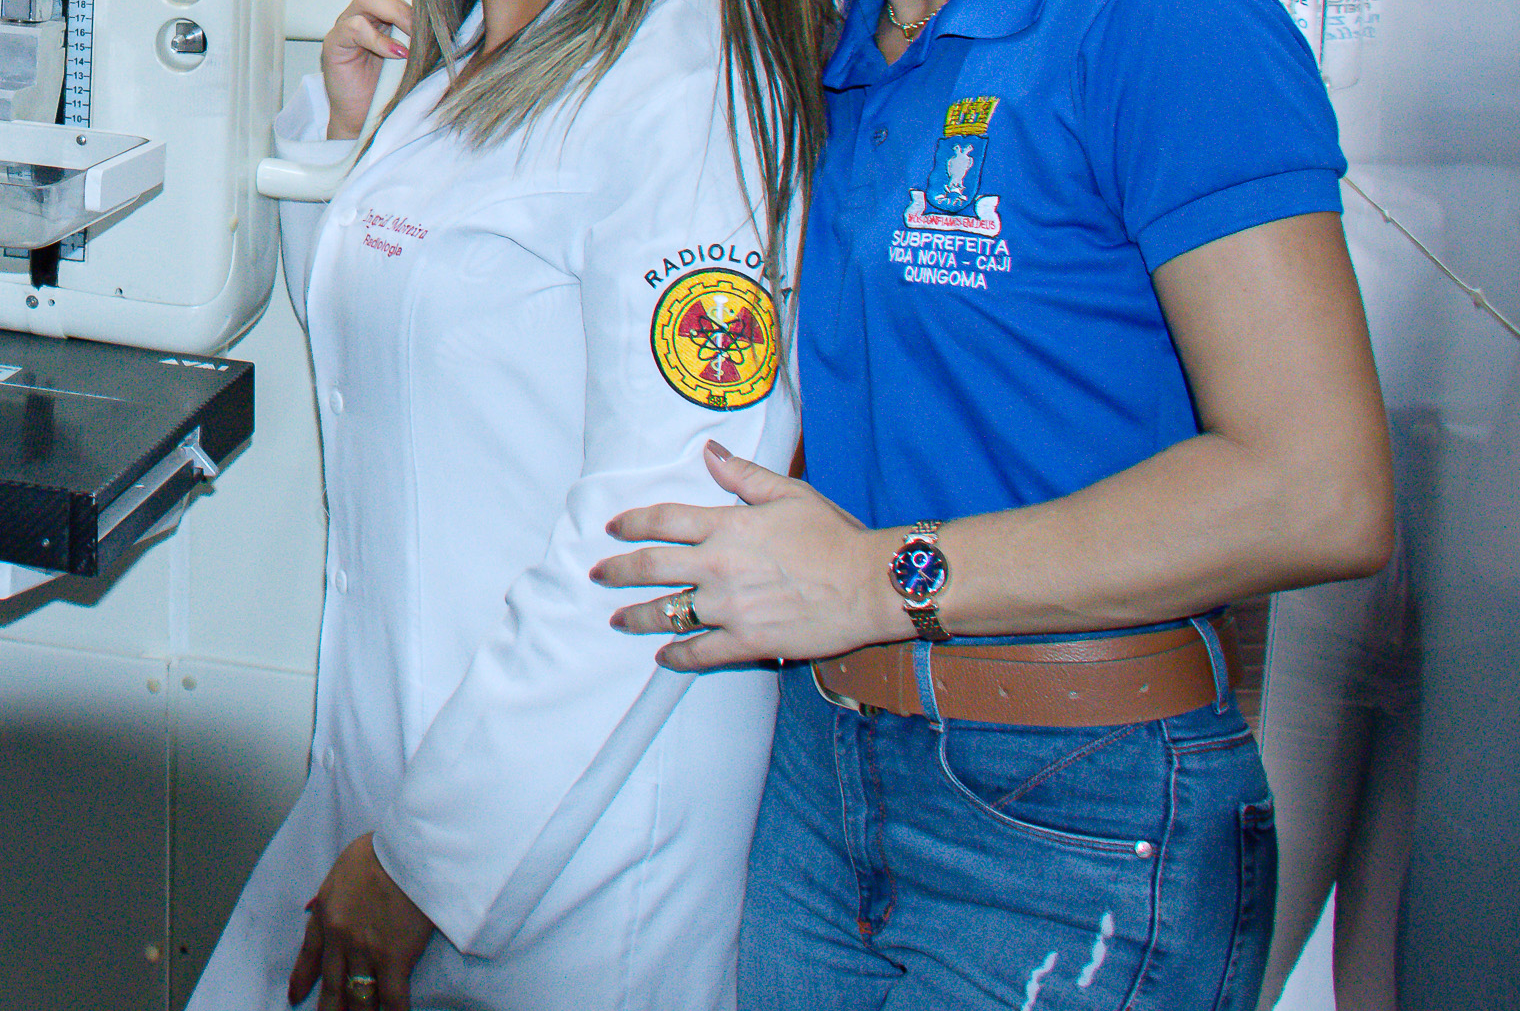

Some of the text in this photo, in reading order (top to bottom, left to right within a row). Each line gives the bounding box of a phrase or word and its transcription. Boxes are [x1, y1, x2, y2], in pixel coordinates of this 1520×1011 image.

[73, 86, 83, 94] 12
[891, 230, 1010, 256] SUBPREFEITA
[917, 249, 957, 268] NOVA
[976, 255, 1012, 273] CAJI
[904, 265, 988, 290] QUINGOMA
